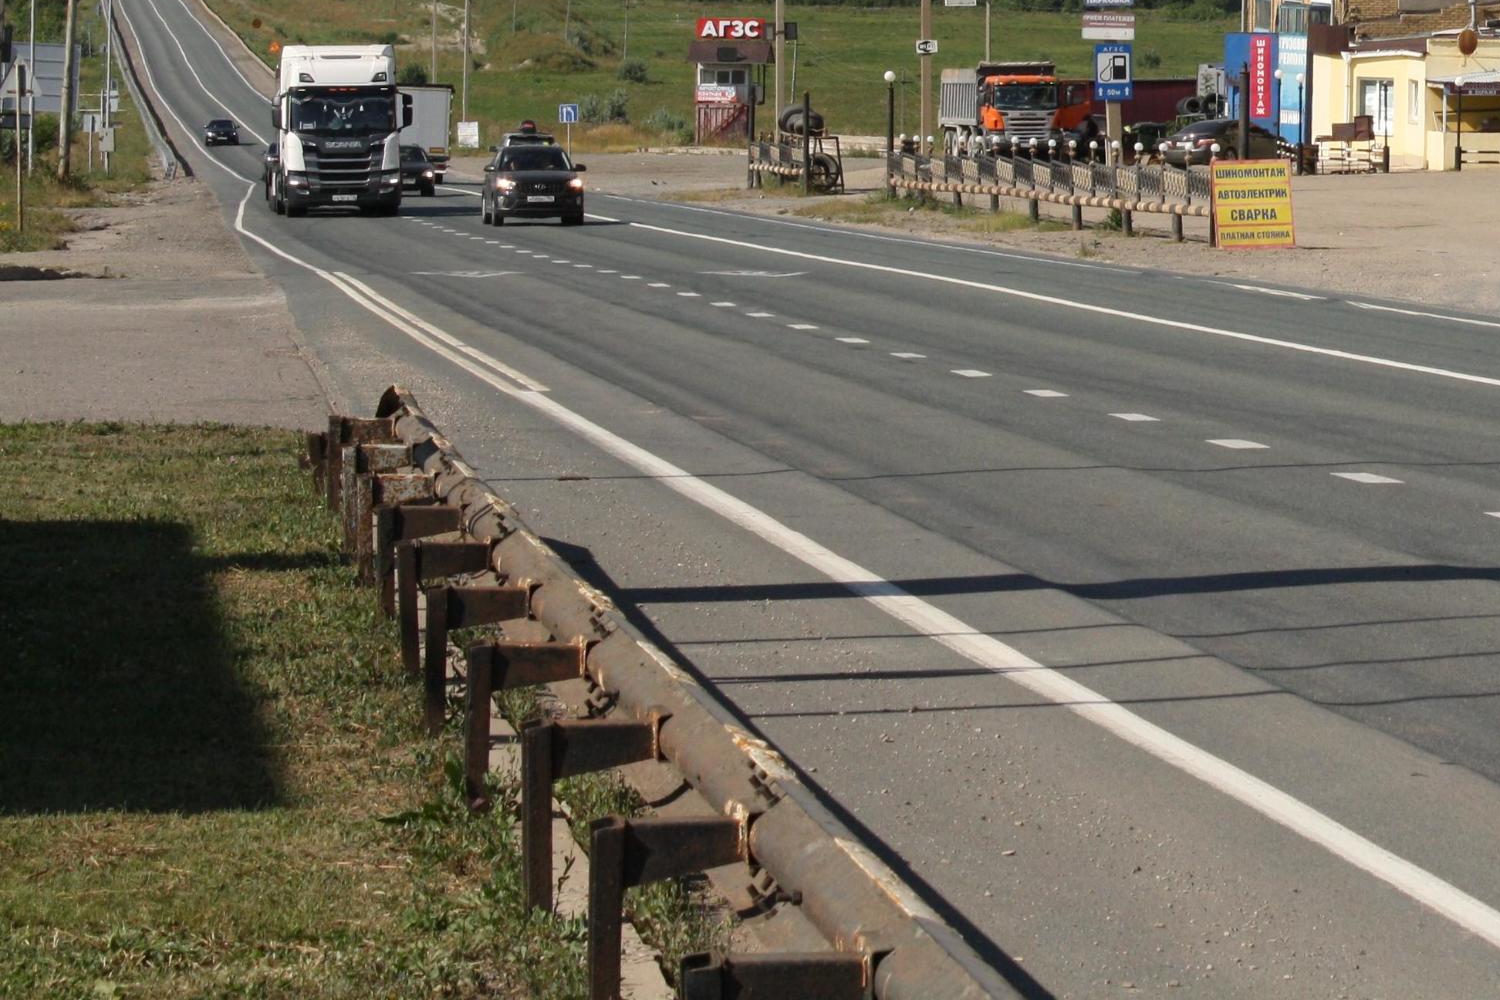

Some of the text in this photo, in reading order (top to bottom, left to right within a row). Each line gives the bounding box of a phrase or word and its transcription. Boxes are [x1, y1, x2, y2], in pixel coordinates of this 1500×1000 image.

[701, 20, 759, 38] АГЗС
[1255, 39, 1266, 115] ШИНОМОНТАЖ
[1215, 167, 1286, 179] ШИНОМОНТАЖ
[1217, 188, 1287, 200] АВТОЭЛЕКТРИК
[1230, 208, 1277, 221] СВАРКА
[1220, 230, 1290, 240] ПЛАТНАЯ СТОЯНКА
